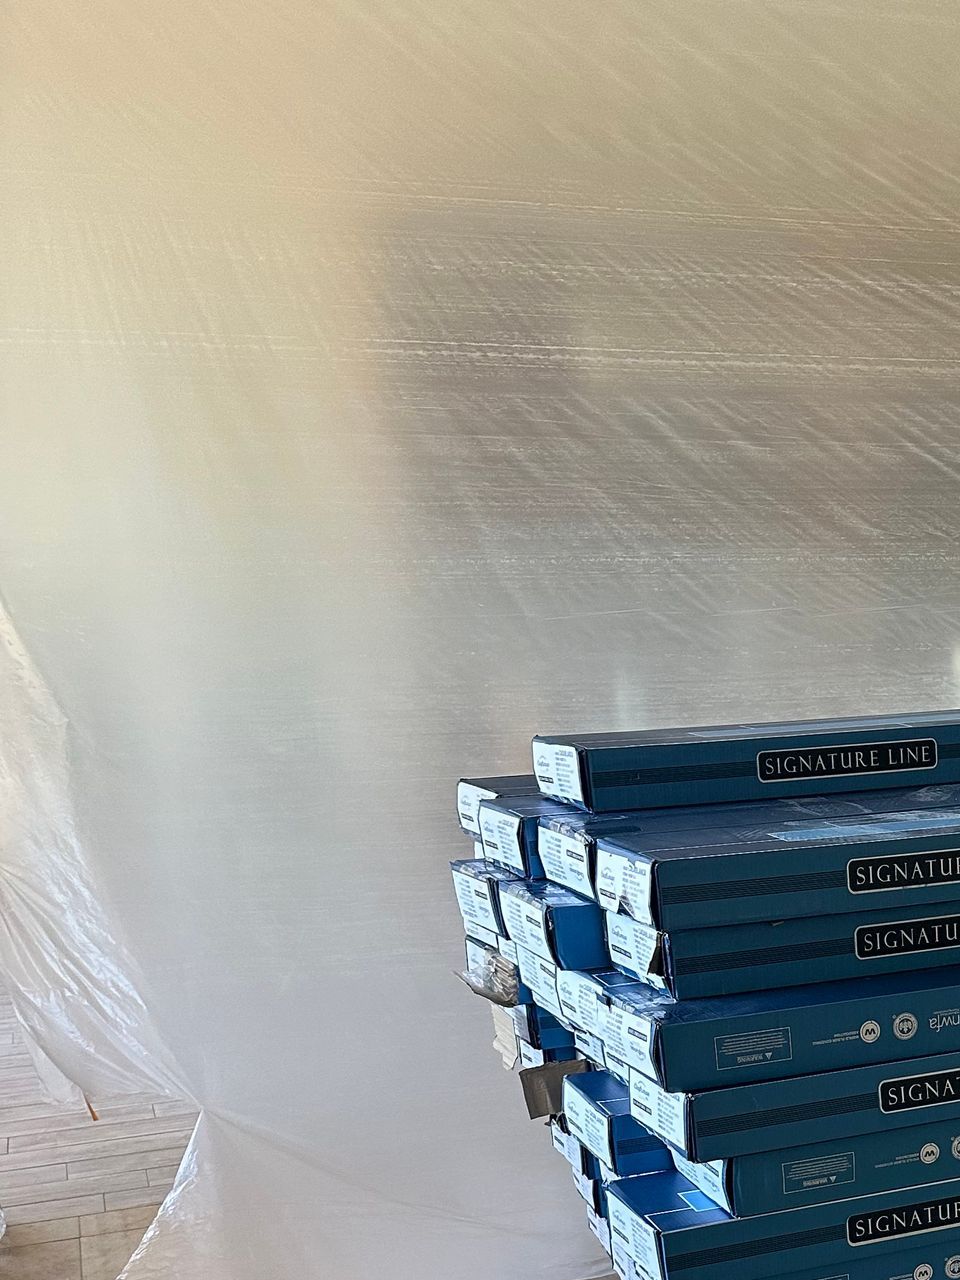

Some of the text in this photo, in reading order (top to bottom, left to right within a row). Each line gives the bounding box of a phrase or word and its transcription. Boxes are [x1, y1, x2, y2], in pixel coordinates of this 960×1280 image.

[765, 745, 930, 775] SIGNATURE LINE
[928, 1014, 960, 1032] nwfa
